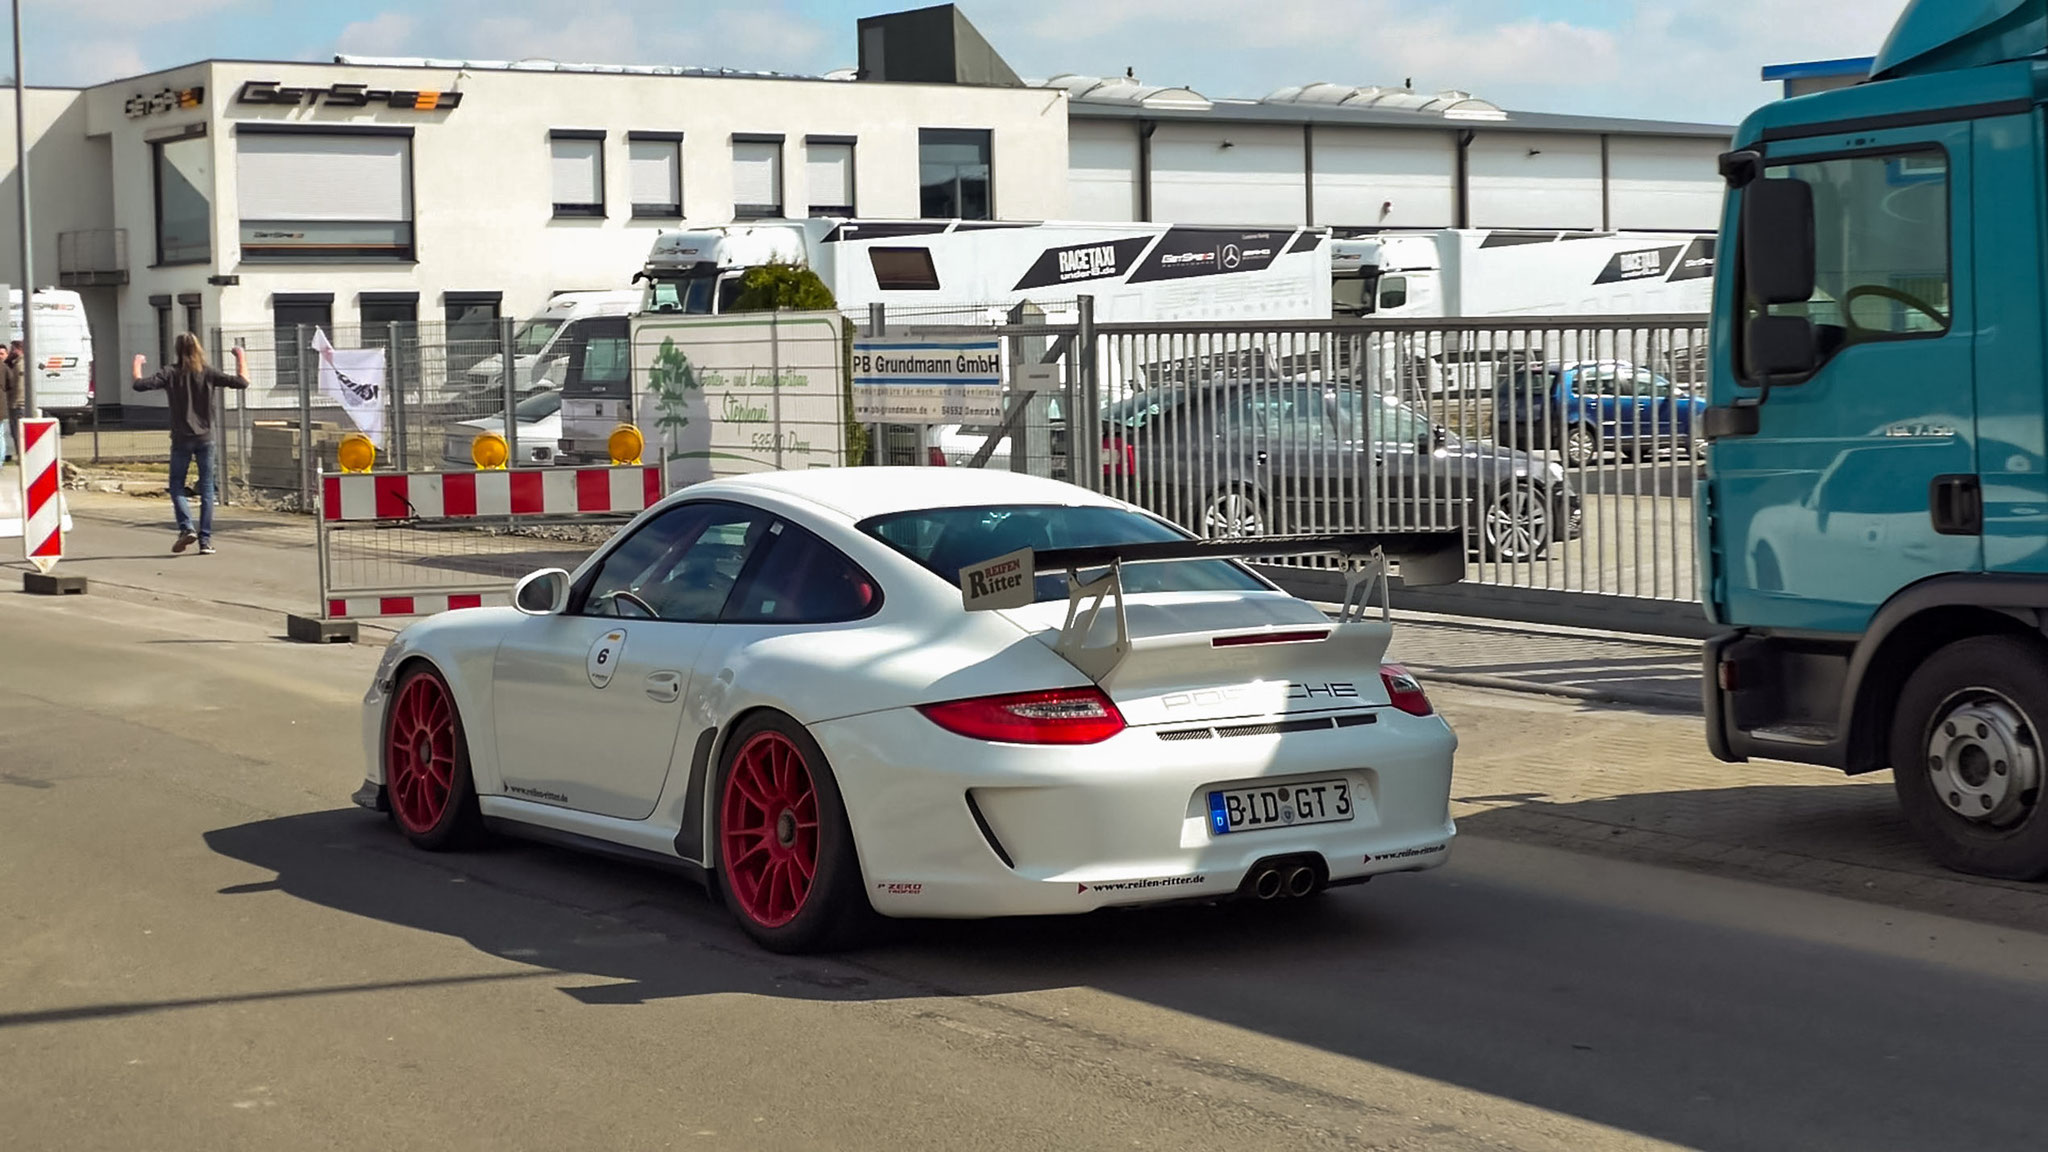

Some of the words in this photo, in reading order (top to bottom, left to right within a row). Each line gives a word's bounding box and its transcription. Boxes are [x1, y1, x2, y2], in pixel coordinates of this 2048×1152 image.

[1059, 246, 1115, 272] RACETAXI
[853, 355, 871, 373] PB
[875, 355, 952, 373] Grundmann
[956, 354, 1000, 373] GmbH
[984, 559, 1021, 578] REIFEN
[968, 571, 1022, 599] Ritter
[597, 648, 610, 665] 6
[1295, 786, 1326, 819] GT
[1334, 784, 1350, 815] 3
[1216, 816, 1225, 827] D
[1093, 874, 1206, 892] www.reifen-ritter.de
